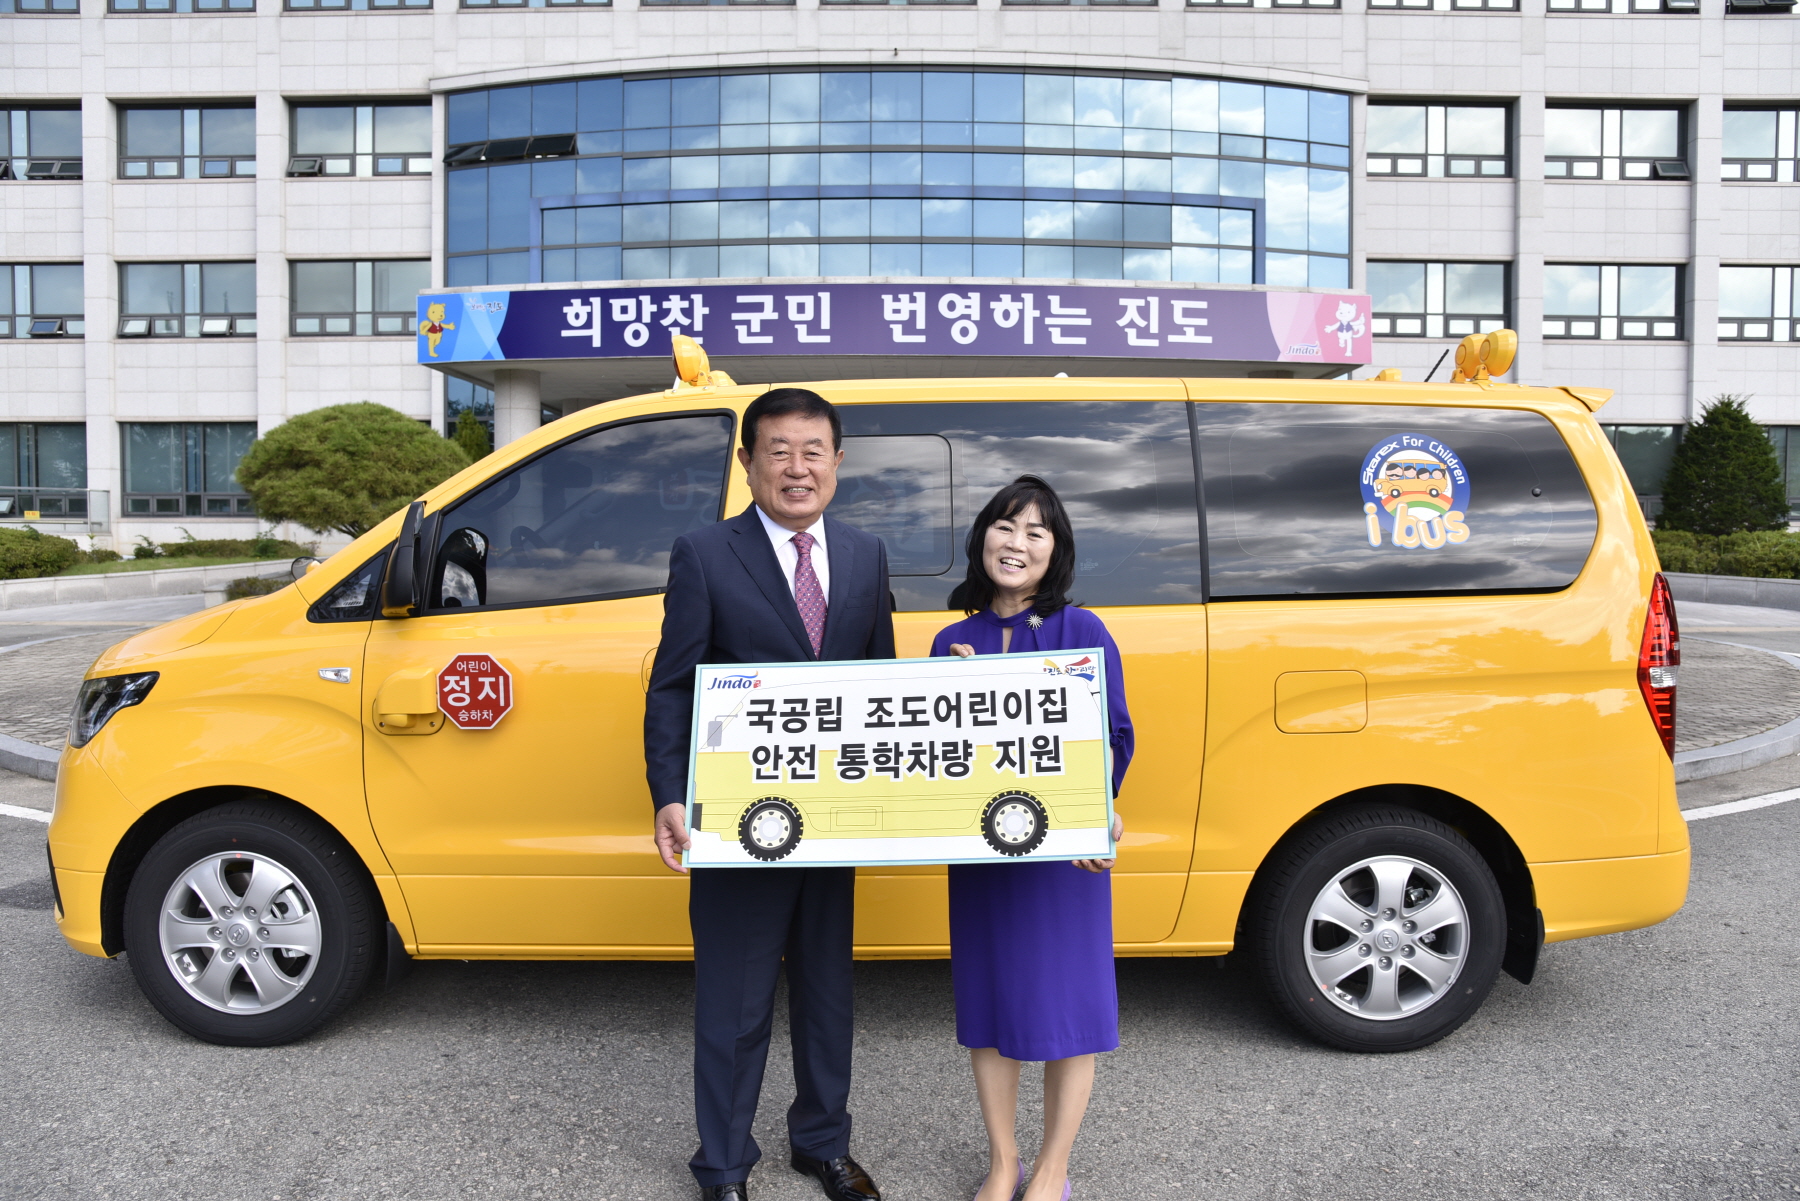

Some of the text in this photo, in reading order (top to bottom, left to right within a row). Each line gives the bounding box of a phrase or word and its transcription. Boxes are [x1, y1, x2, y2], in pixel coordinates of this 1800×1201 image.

[561, 291, 1213, 347] 희망찬 군민 번영하는 진도
[1286, 345, 1315, 355] Jindo
[1362, 435, 1466, 485] Starex For Children
[1363, 501, 1470, 550] i bus
[456, 660, 491, 673] 어린이
[707, 677, 753, 690] Jindo
[442, 675, 505, 707] 정지
[746, 687, 1068, 733] 국공립 조도어린이집
[458, 709, 494, 722] 승하차
[751, 734, 1062, 780] 안전 통학차량 지원
